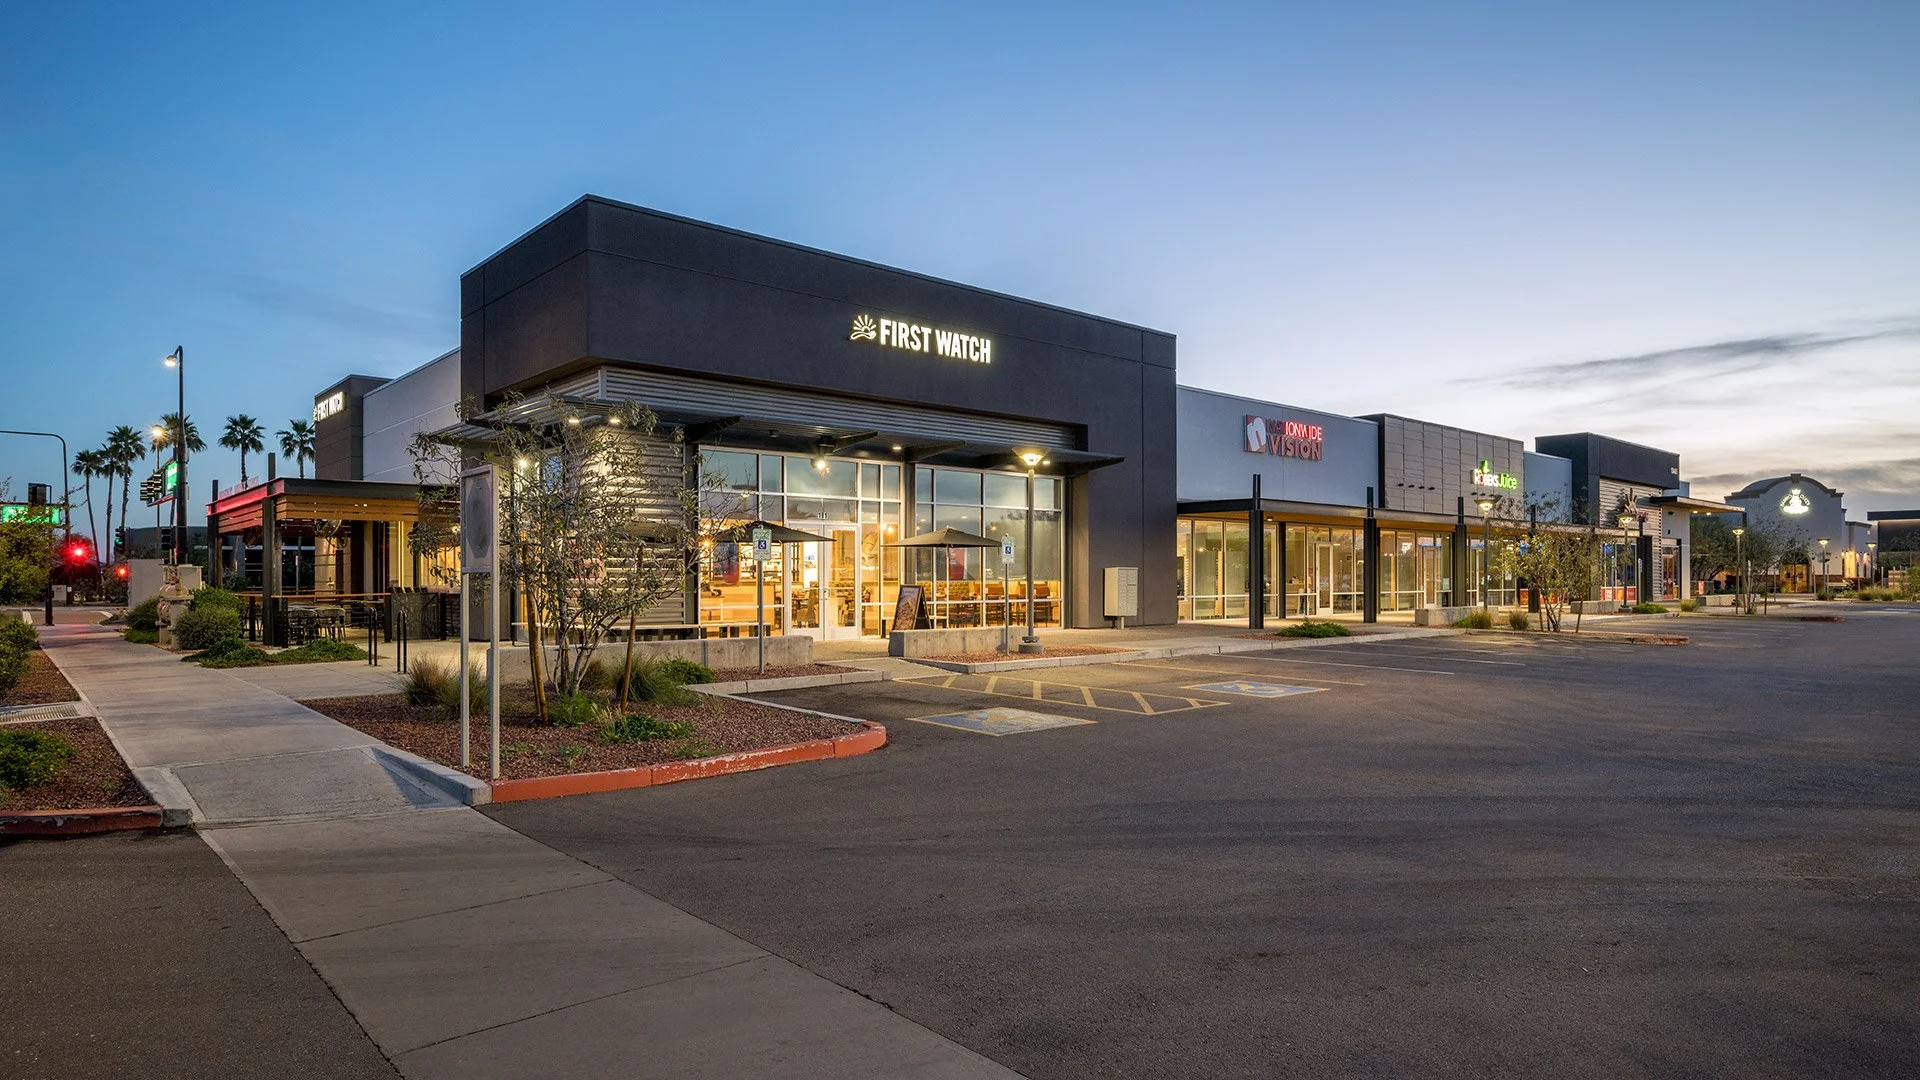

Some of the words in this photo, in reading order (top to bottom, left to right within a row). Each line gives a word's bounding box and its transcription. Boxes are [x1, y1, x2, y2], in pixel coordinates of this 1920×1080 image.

[880, 318, 931, 353] FIRST
[935, 329, 991, 364] WATCH
[1268, 433, 1323, 461] VISION
